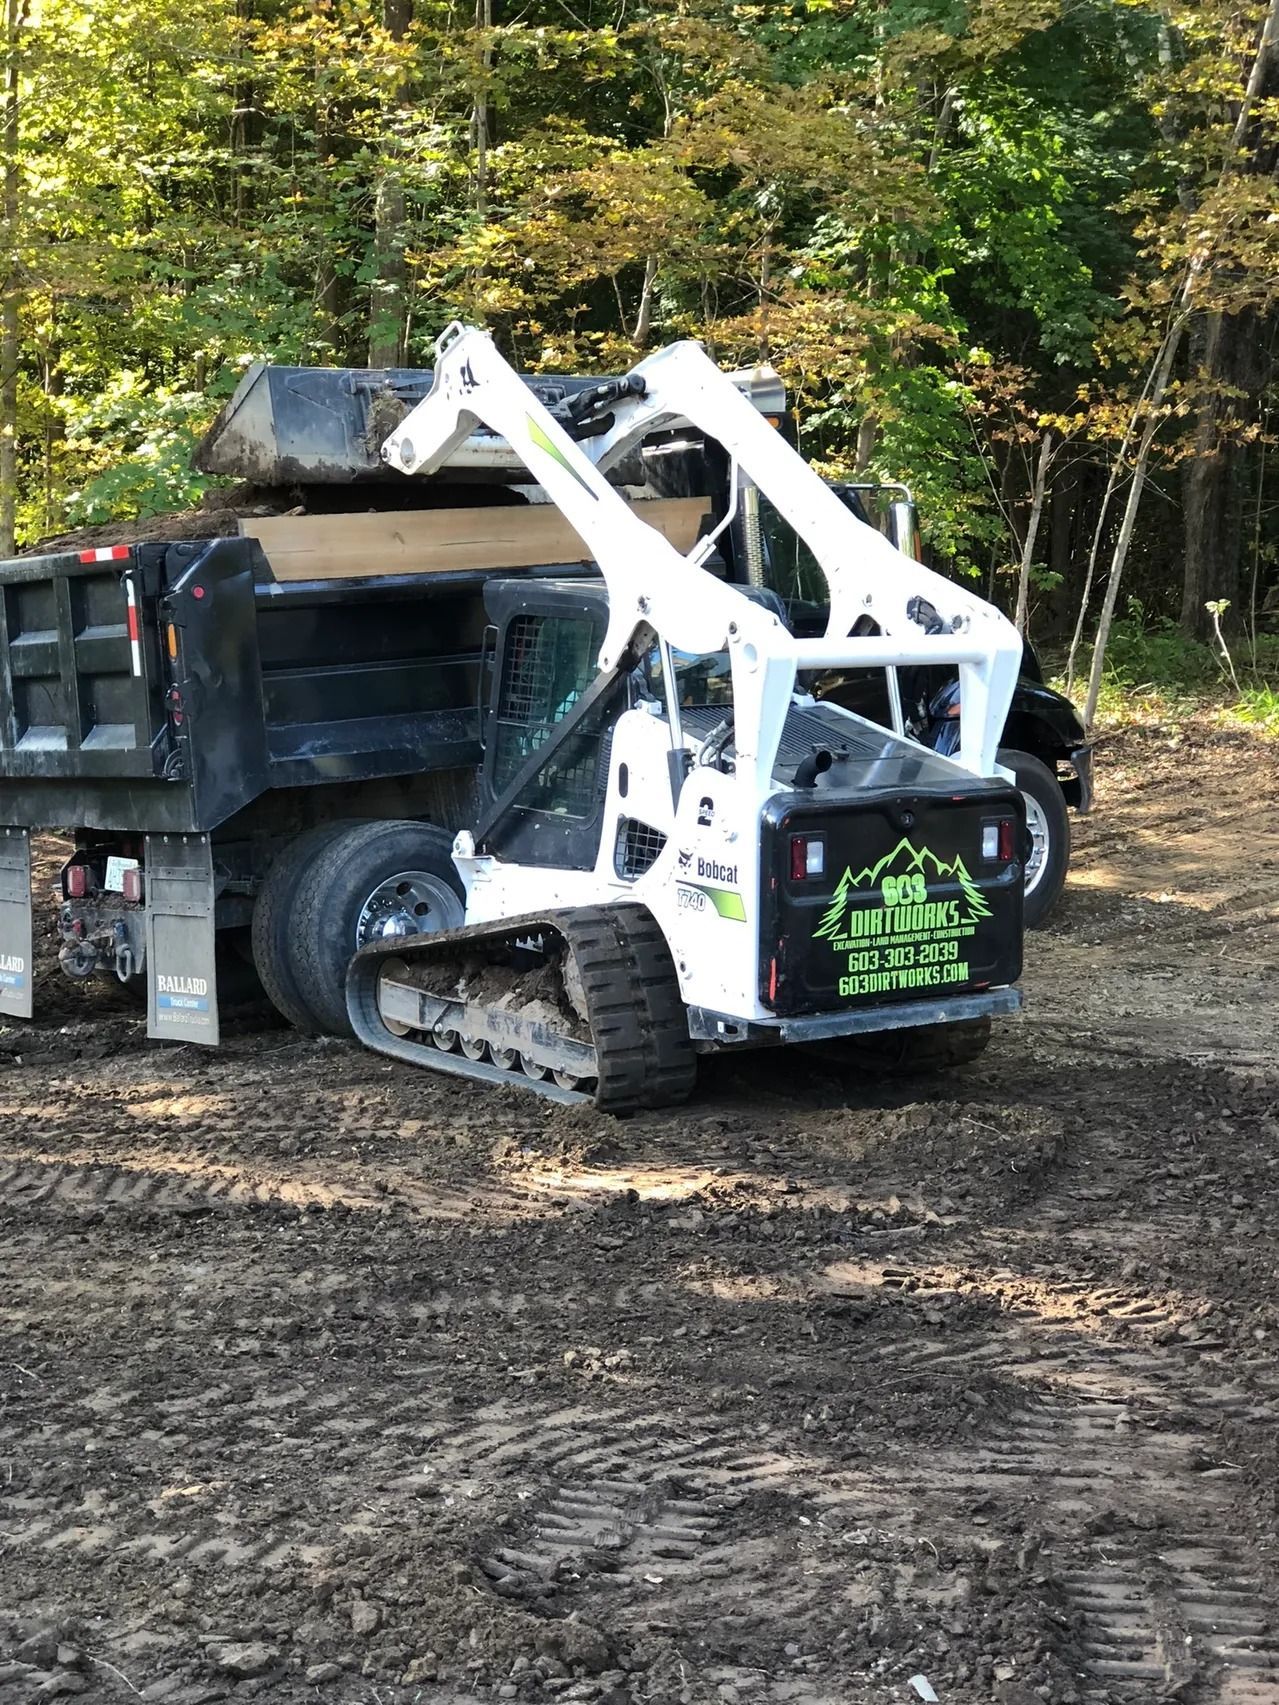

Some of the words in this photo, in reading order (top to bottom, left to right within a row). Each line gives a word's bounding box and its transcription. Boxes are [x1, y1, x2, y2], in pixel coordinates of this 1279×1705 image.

[697, 857, 738, 884] Bobcat
[677, 888, 706, 912] T740
[881, 873, 928, 906] 603
[851, 900, 959, 937] DIRTWORKS
[848, 941, 958, 972] 603-303-2039
[157, 974, 208, 996] BALLARD
[838, 962, 969, 996] 603DIRTWORKS.COM
